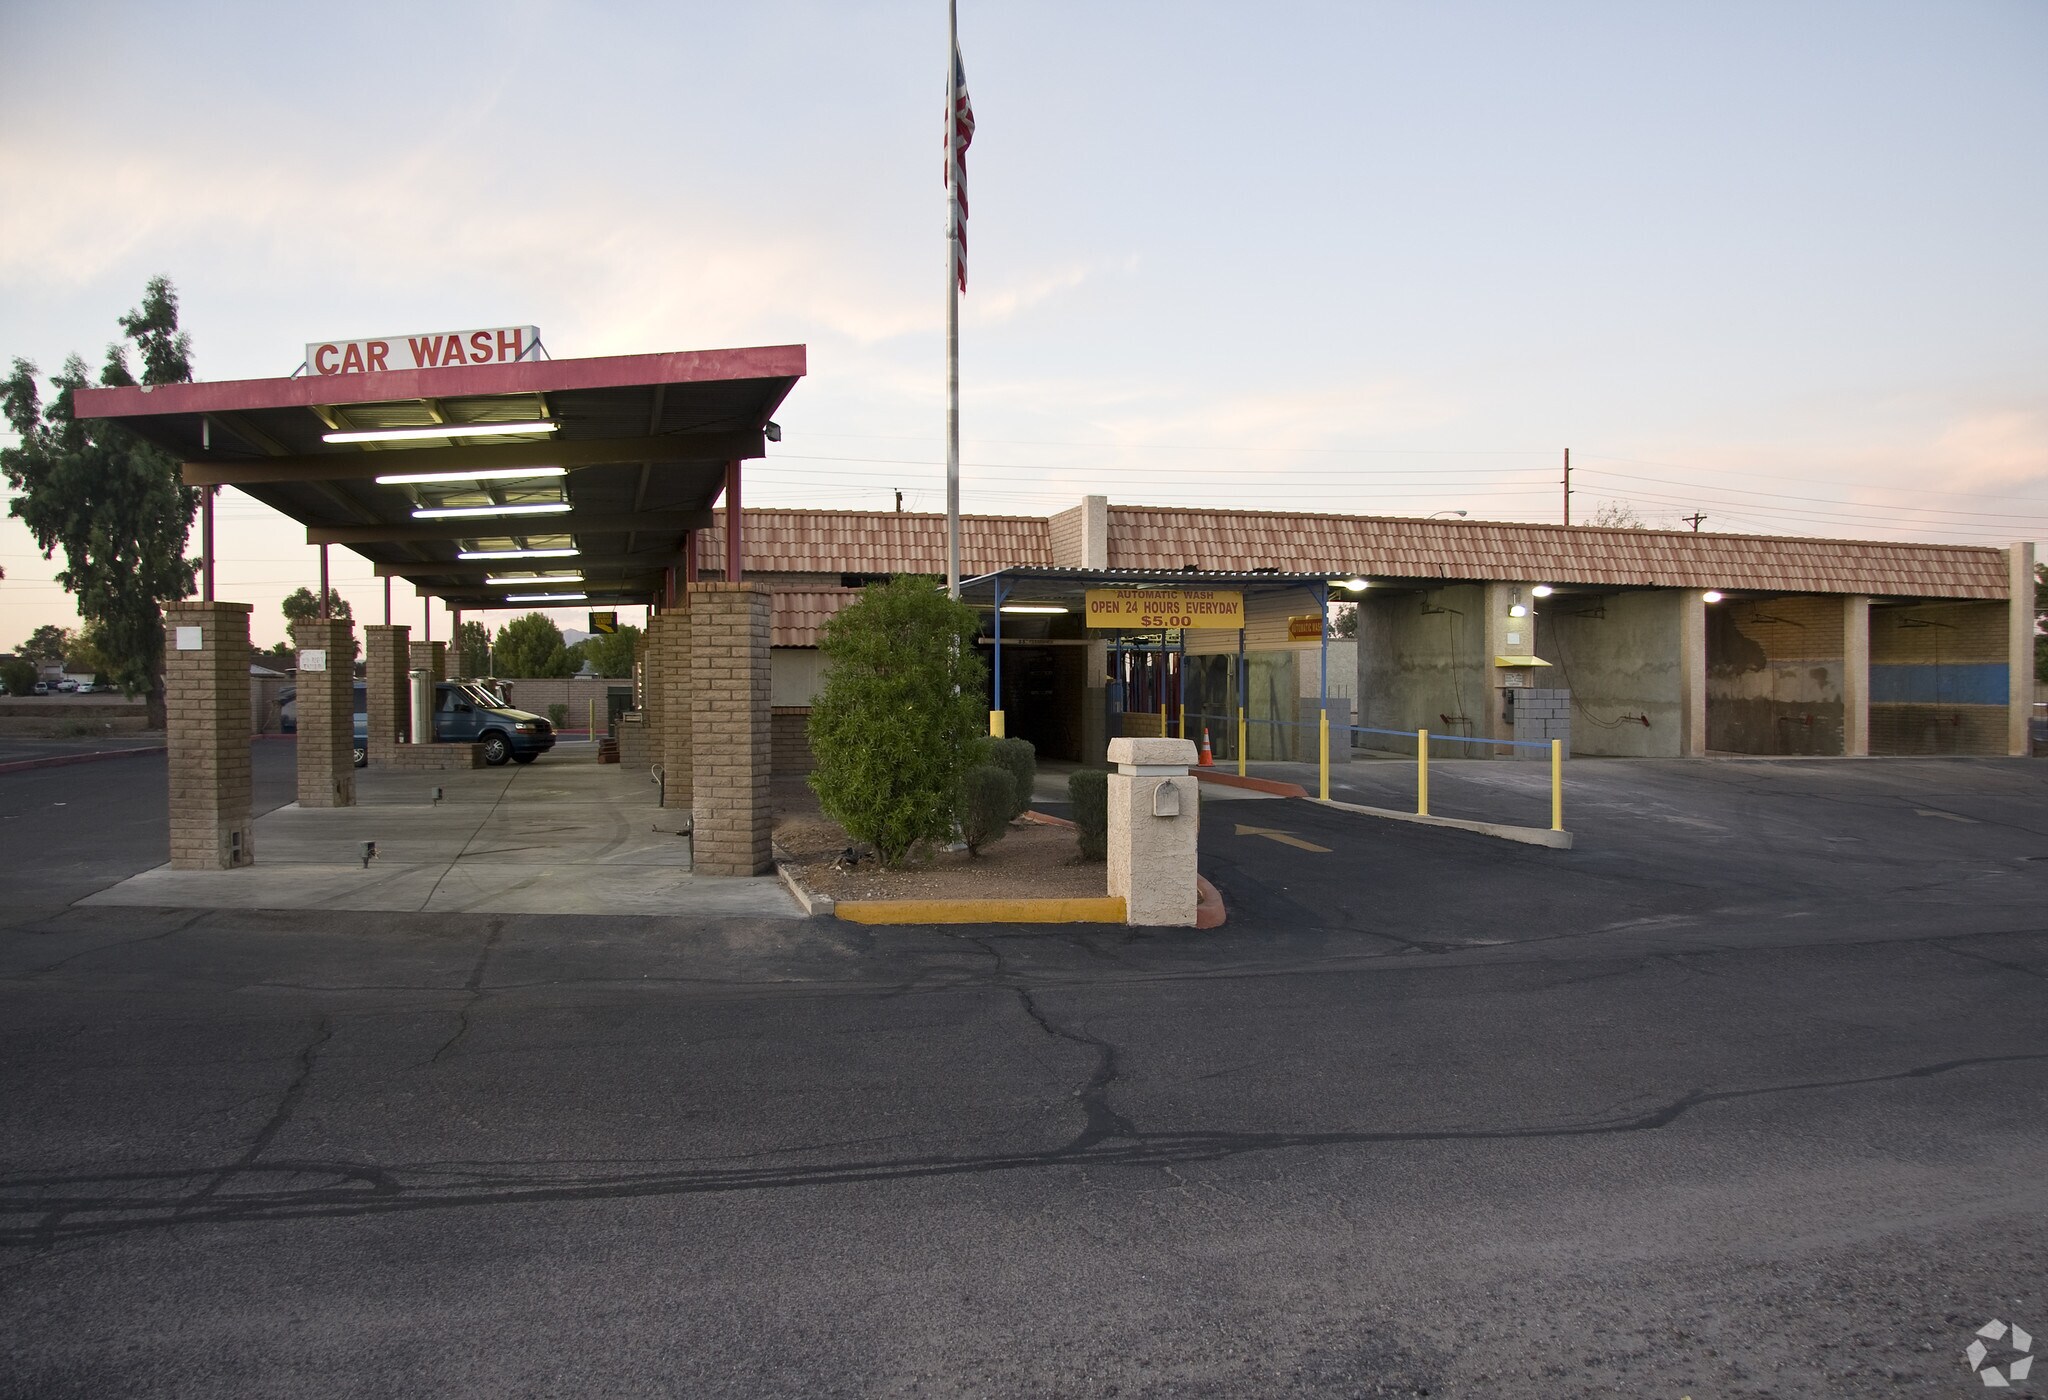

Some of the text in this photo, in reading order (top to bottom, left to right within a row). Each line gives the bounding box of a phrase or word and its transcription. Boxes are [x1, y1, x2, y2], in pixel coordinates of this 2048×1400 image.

[315, 328, 522, 376] CAR WASH
[1117, 590, 1214, 599] AUTOMATIC WASH
[1091, 601, 1238, 614] OPEN 24 HOURS EVERYDAY
[1141, 615, 1191, 627] $5.00
